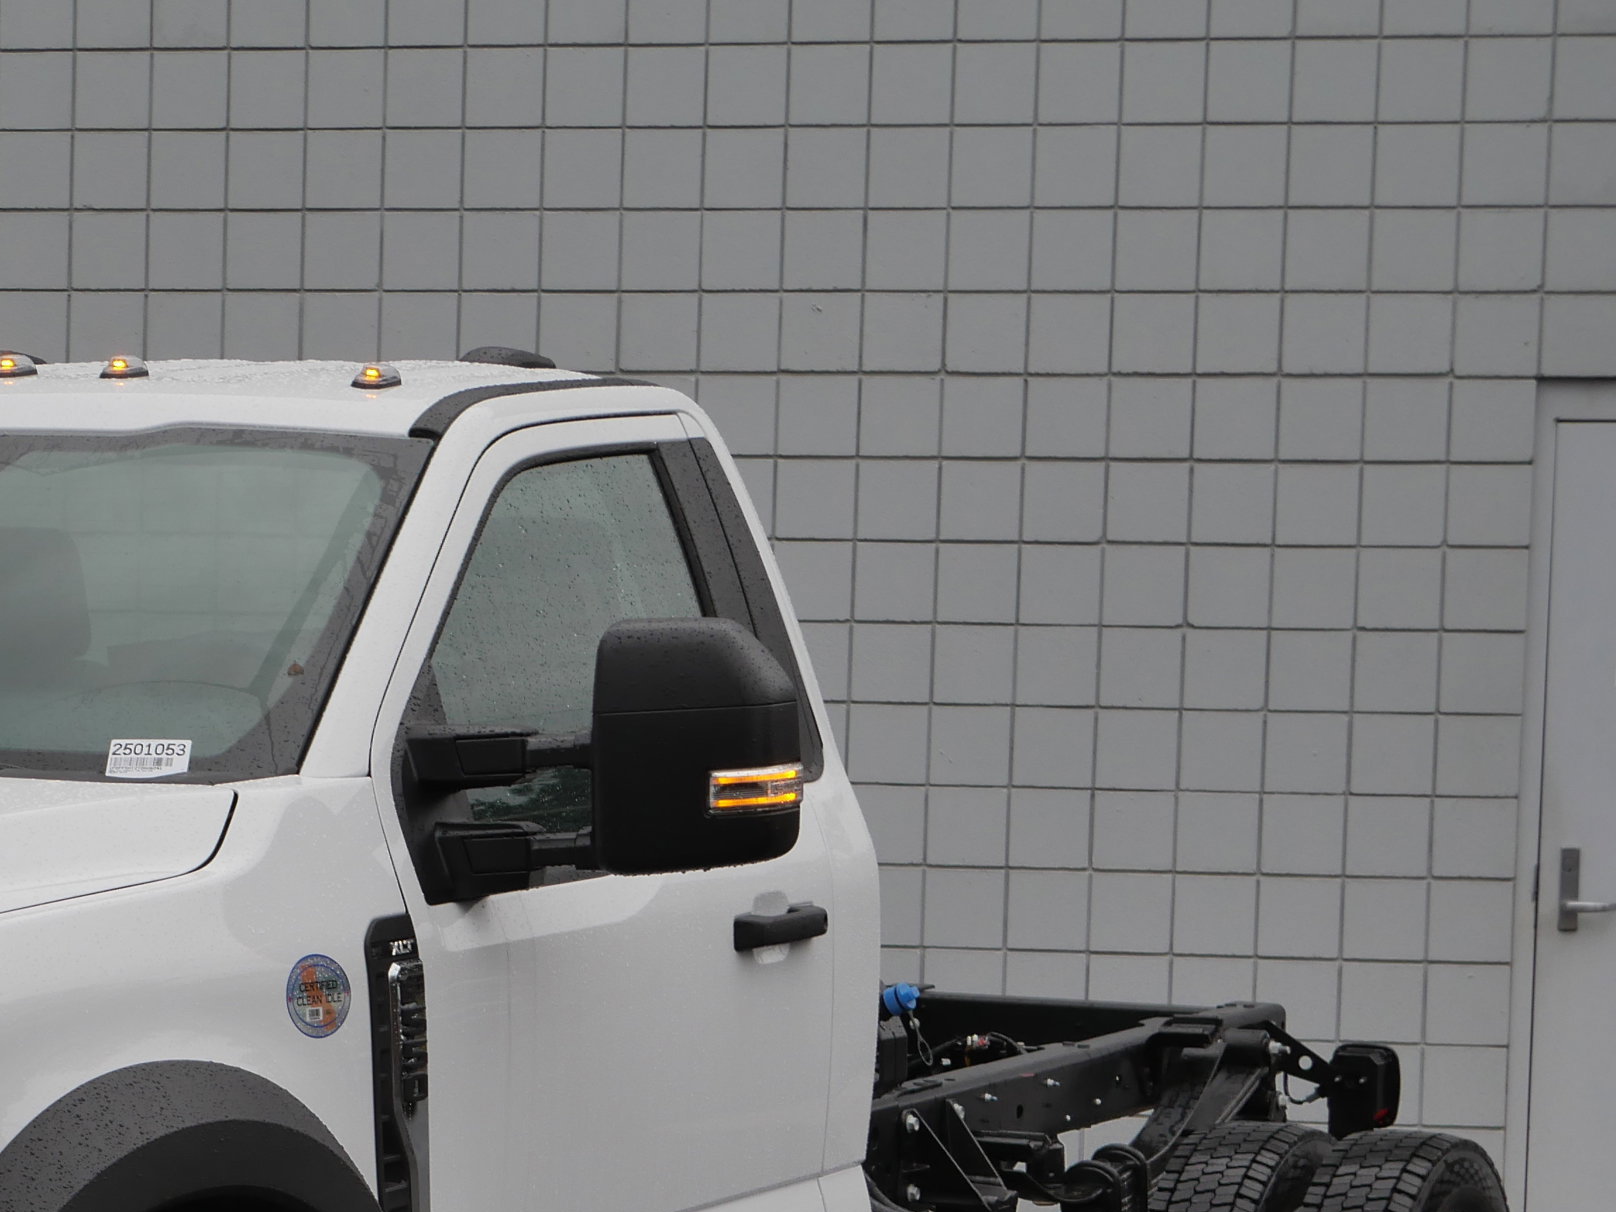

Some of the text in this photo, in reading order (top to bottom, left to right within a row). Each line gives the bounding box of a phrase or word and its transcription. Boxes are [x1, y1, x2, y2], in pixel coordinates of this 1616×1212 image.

[112, 743, 186, 757] 2501053
[389, 940, 415, 956] XLT
[299, 979, 338, 993] CERTIFIED
[296, 994, 322, 1006] CLEAN
